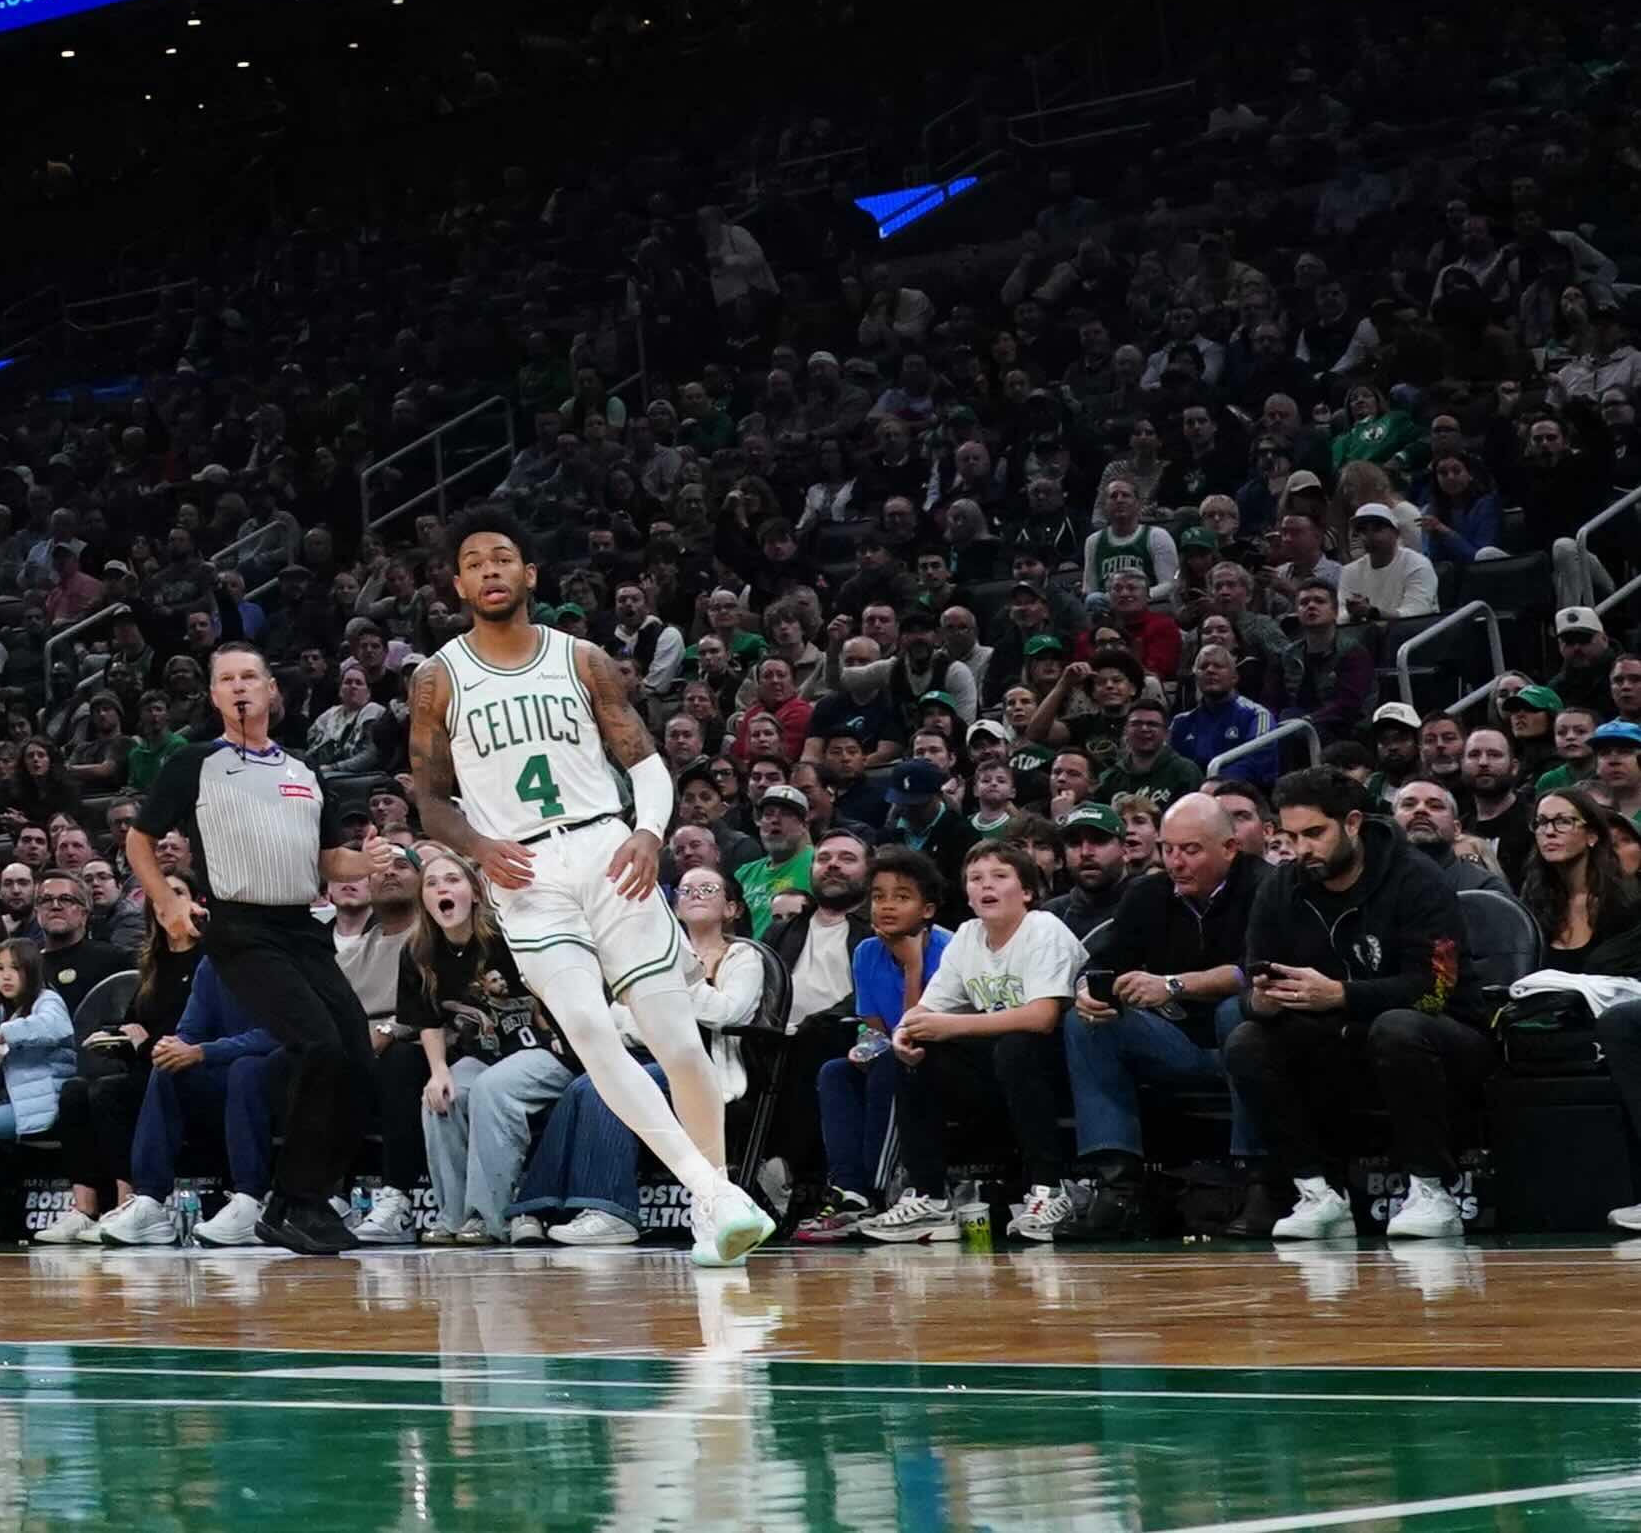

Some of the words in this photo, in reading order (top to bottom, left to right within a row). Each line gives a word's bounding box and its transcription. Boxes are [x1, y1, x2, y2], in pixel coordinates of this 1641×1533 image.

[466, 693, 580, 758] CELTICS
[515, 753, 566, 819] 4
[518, 1026, 537, 1047] 0
